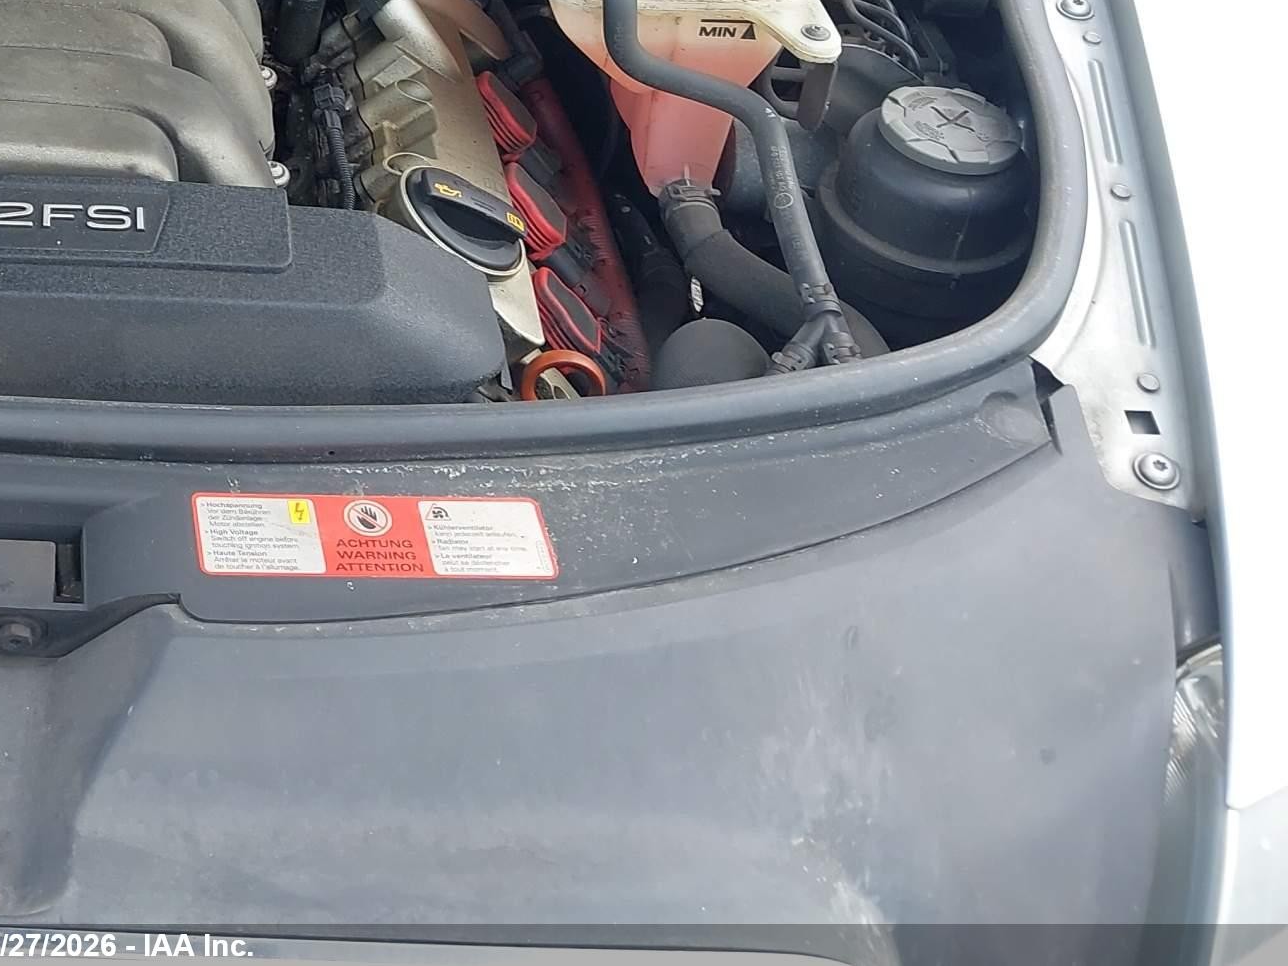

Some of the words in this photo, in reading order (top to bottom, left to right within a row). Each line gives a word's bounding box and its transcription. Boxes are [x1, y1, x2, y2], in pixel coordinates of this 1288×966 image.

[699, 26, 737, 38] MIN
[206, 501, 263, 510] Hochspannung
[336, 539, 413, 548] ACHTUNG
[336, 551, 417, 560] WARNING
[336, 563, 425, 572] ATTENTION
